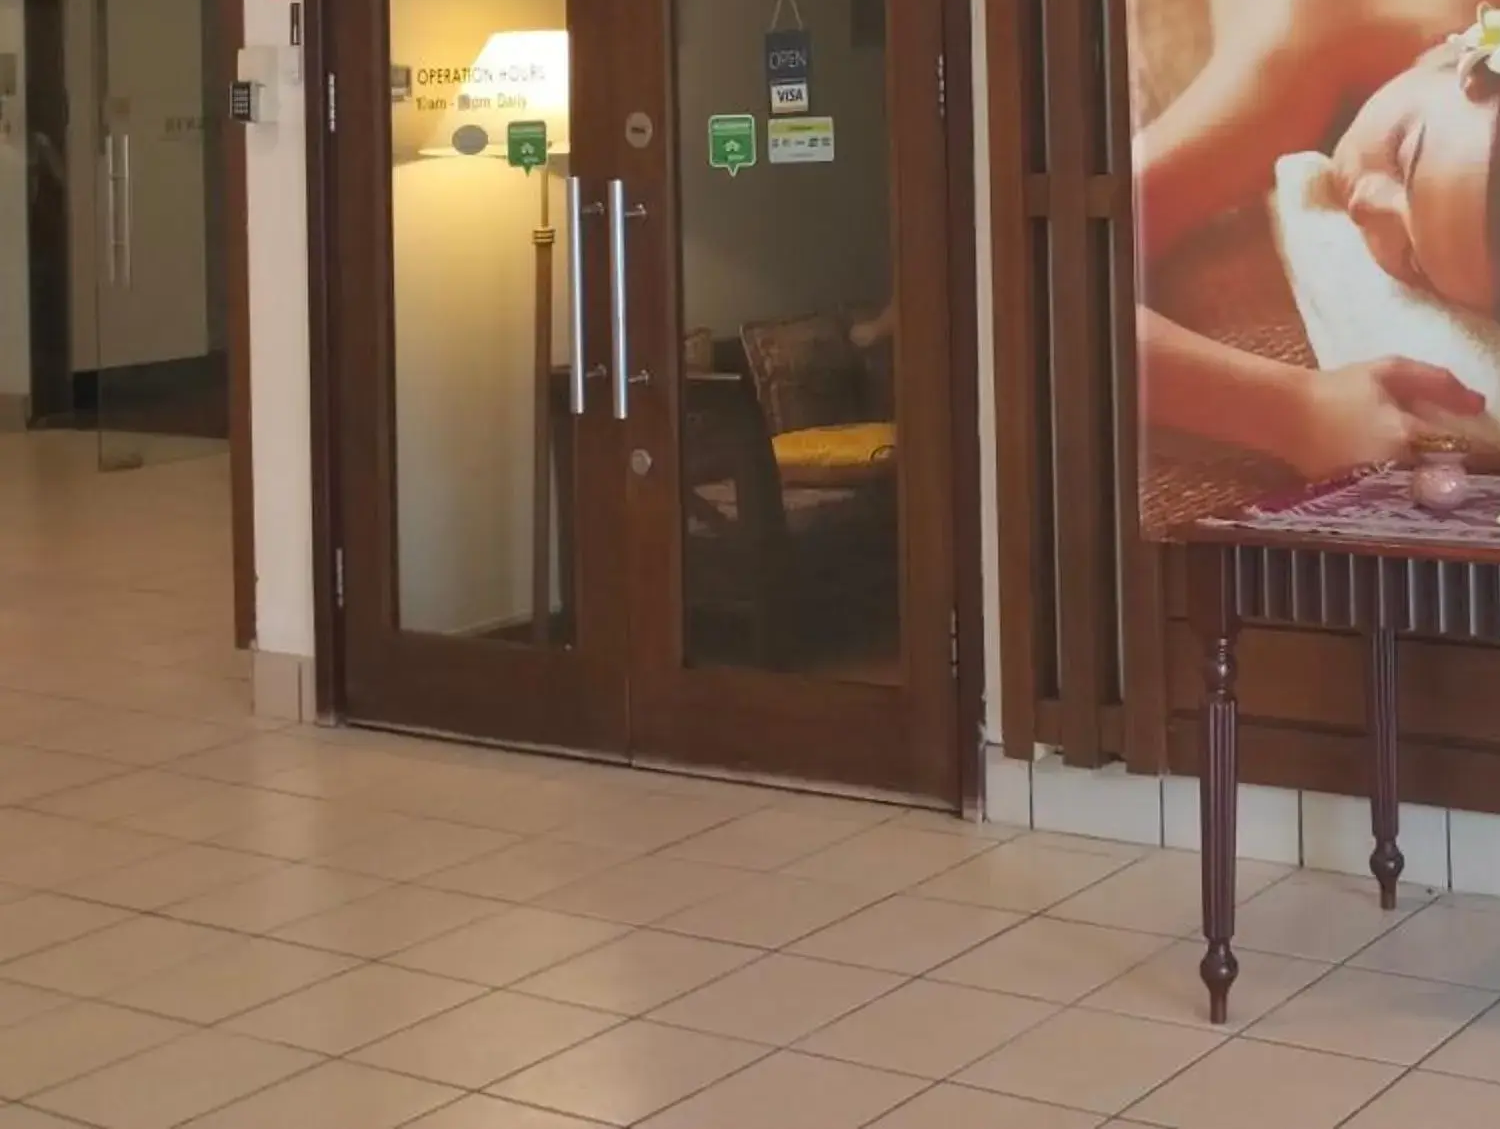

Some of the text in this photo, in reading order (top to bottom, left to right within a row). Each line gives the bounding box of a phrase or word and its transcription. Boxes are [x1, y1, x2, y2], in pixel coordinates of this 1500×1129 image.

[770, 46, 806, 70] OPEN
[416, 65, 493, 86] OPERATION
[497, 91, 528, 111] Daily
[777, 88, 804, 103] VISA
